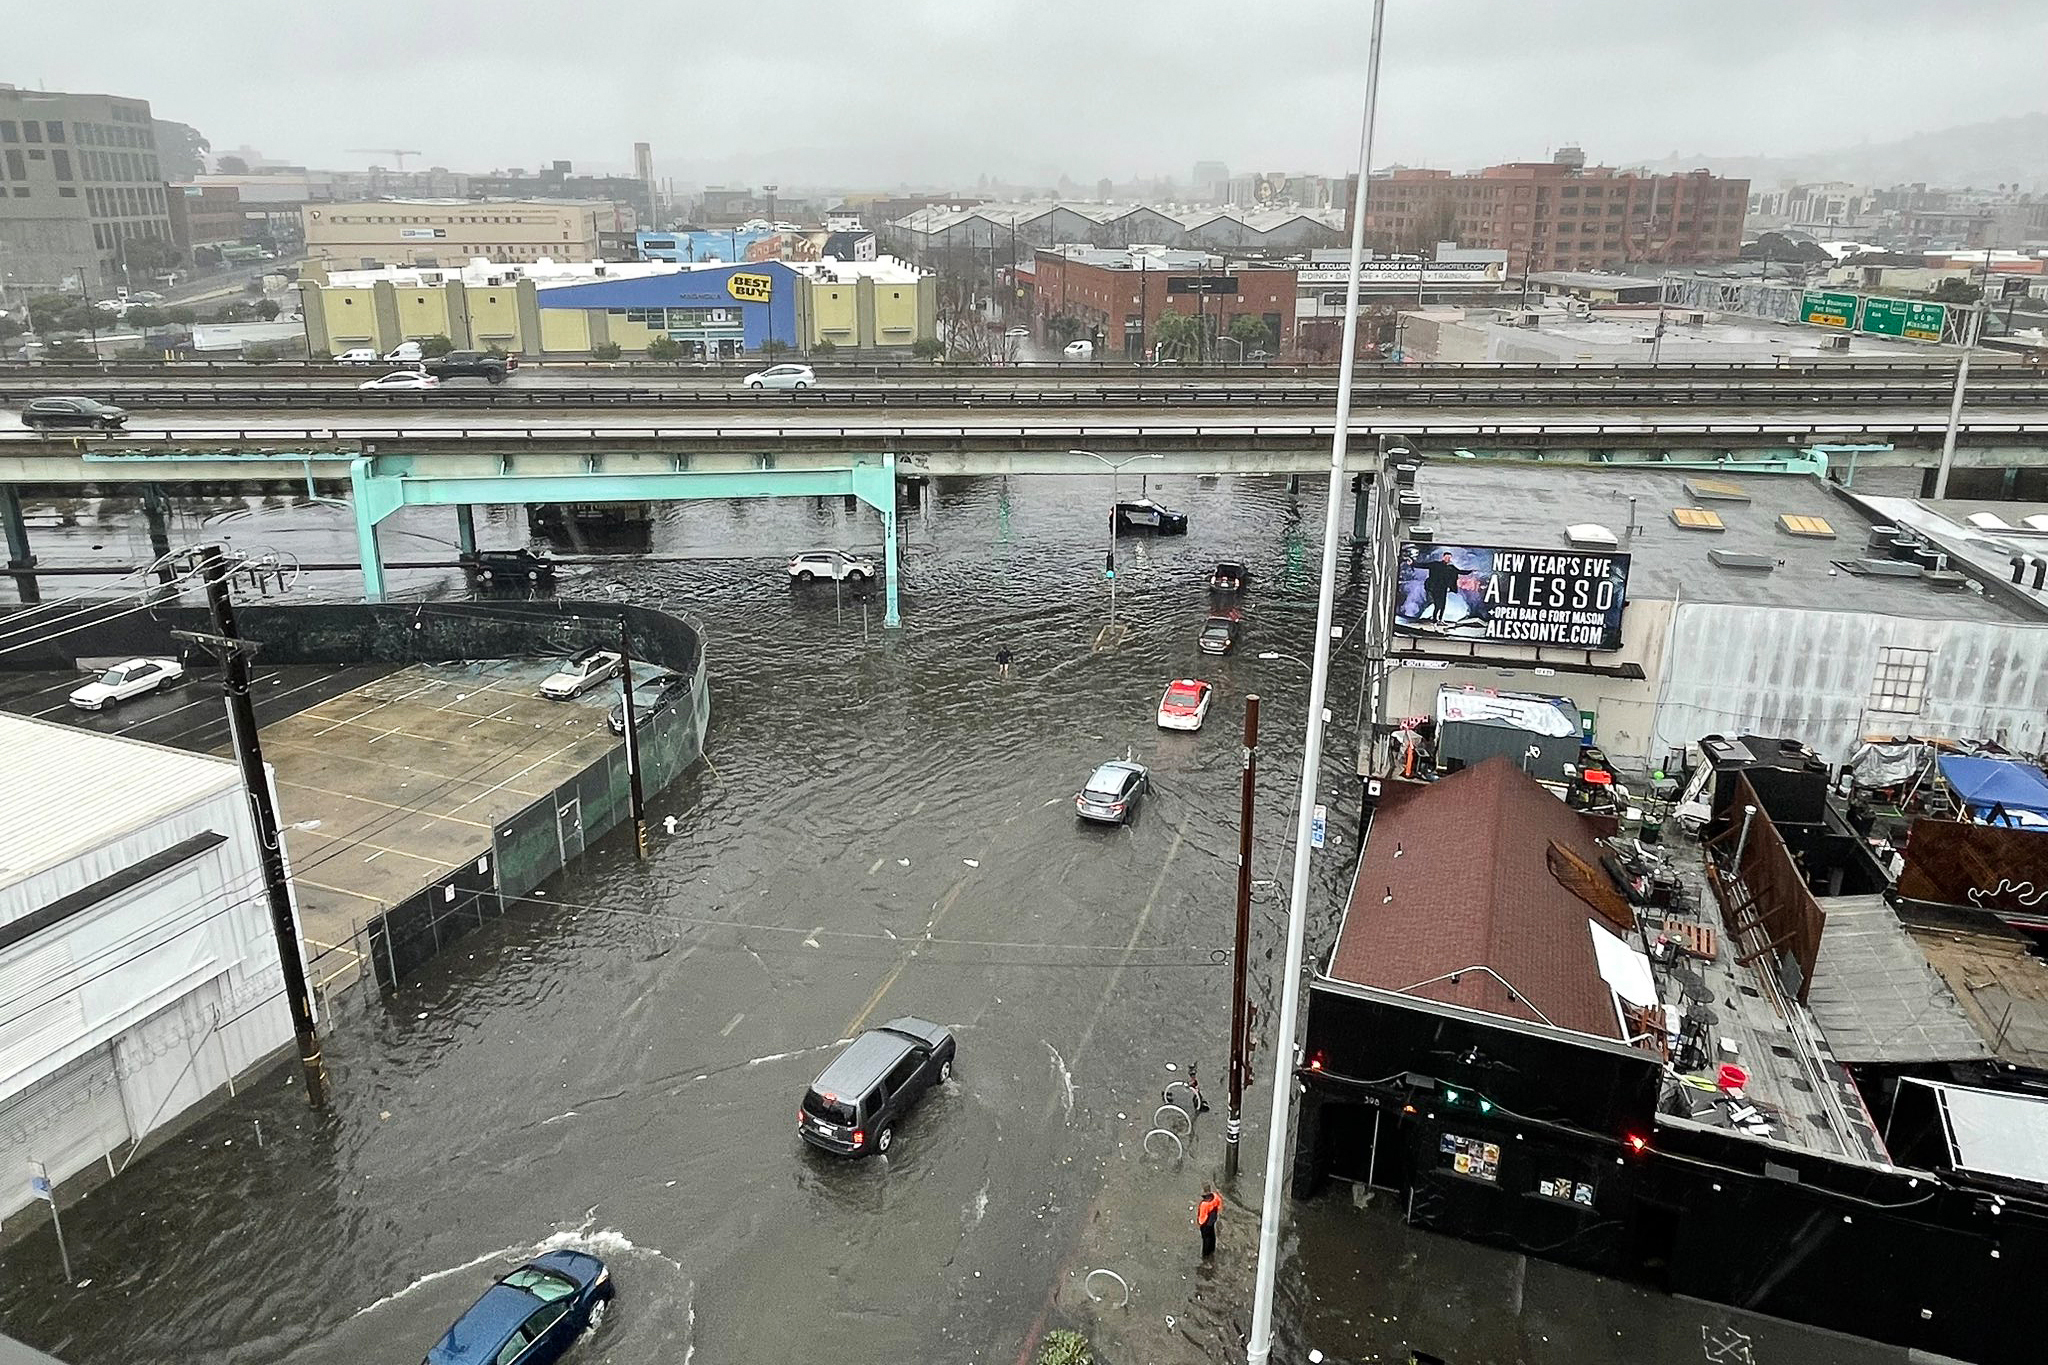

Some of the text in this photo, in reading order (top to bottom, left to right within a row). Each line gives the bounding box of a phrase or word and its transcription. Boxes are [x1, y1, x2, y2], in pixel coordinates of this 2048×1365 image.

[734, 276, 769, 288] BEST
[1434, 272, 1471, 280] TRAINING
[735, 286, 767, 297] BUY
[1492, 552, 1612, 578] NEW YEAR'S EVE
[1483, 574, 1614, 611] ALESSO
[1519, 607, 1538, 621] BAR
[1538, 609, 1548, 622] @
[1547, 610, 1572, 624] FORT
[1485, 619, 1603, 645] ALESSONYE.COM
